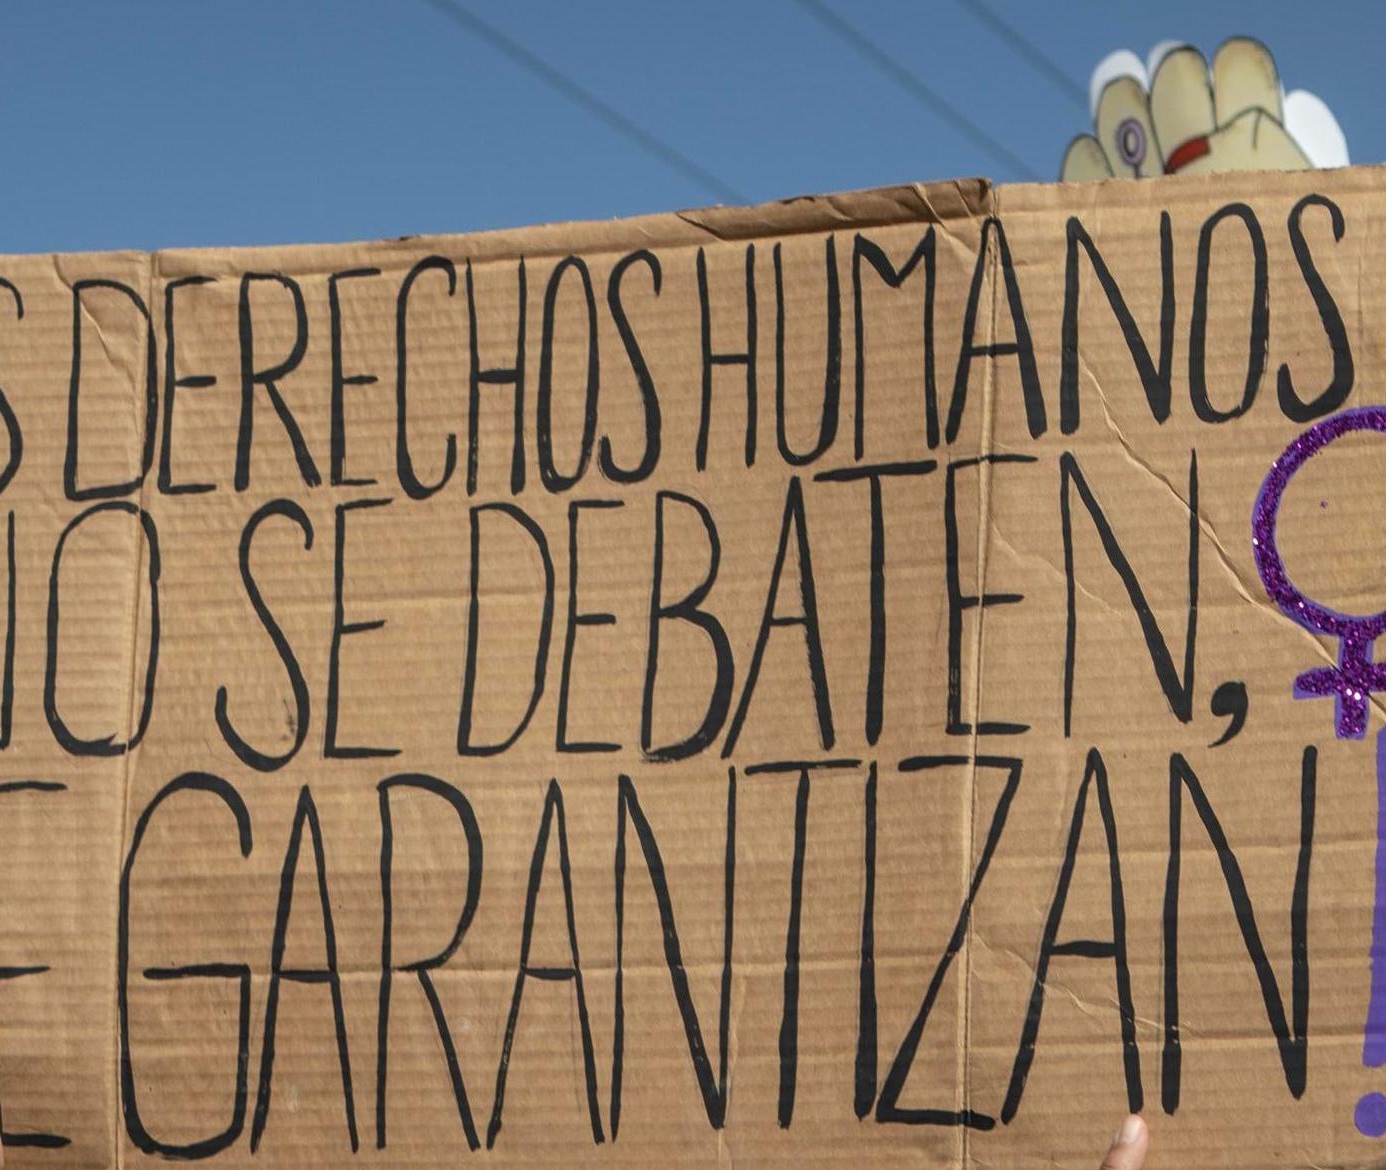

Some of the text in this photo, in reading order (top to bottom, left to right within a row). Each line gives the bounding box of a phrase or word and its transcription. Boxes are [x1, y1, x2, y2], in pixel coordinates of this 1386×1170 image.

[63, 249, 663, 502] DERECHOS
[696, 193, 1356, 472] HUMANOS
[214, 498, 402, 772] SE
[458, 449, 1249, 762] DEBATEN,
